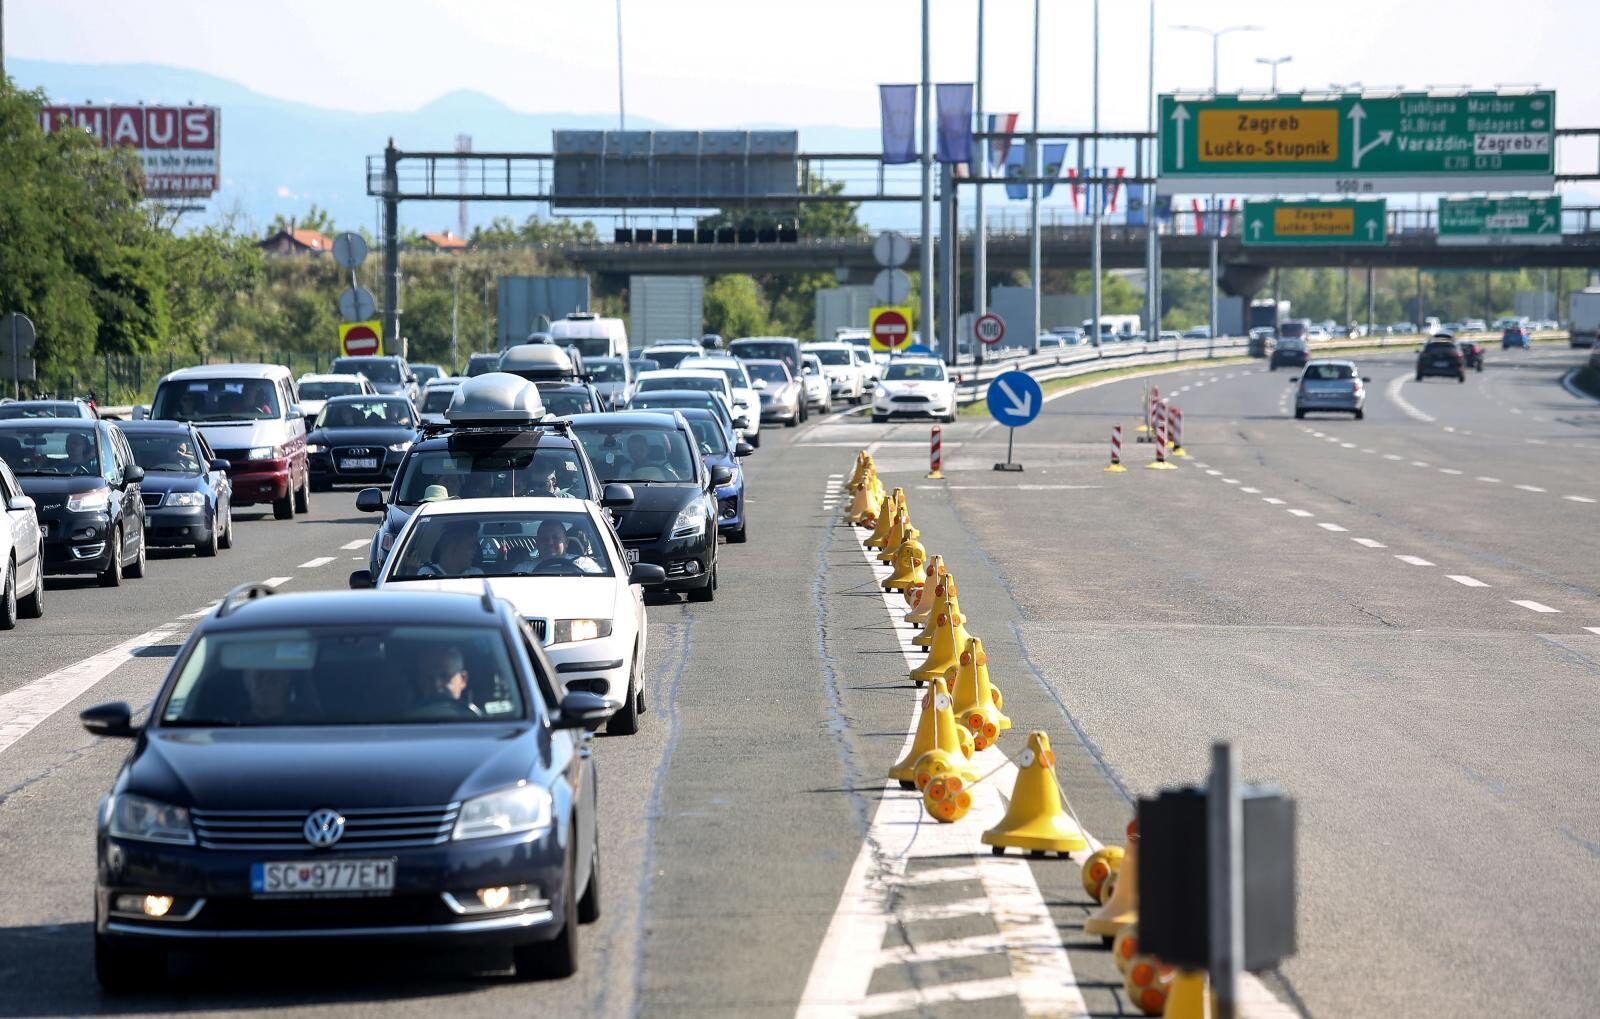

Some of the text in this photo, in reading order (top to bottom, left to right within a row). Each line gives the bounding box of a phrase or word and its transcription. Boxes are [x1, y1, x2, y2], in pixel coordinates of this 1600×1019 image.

[1400, 99, 1456, 116] Ljubljana
[1467, 99, 1514, 113] Maribor
[1238, 115, 1299, 134] Zagreb
[1467, 117, 1525, 133] Budapest
[1336, 180, 1358, 192] 500
[982, 323, 998, 337] 100
[267, 865, 297, 889] SC
